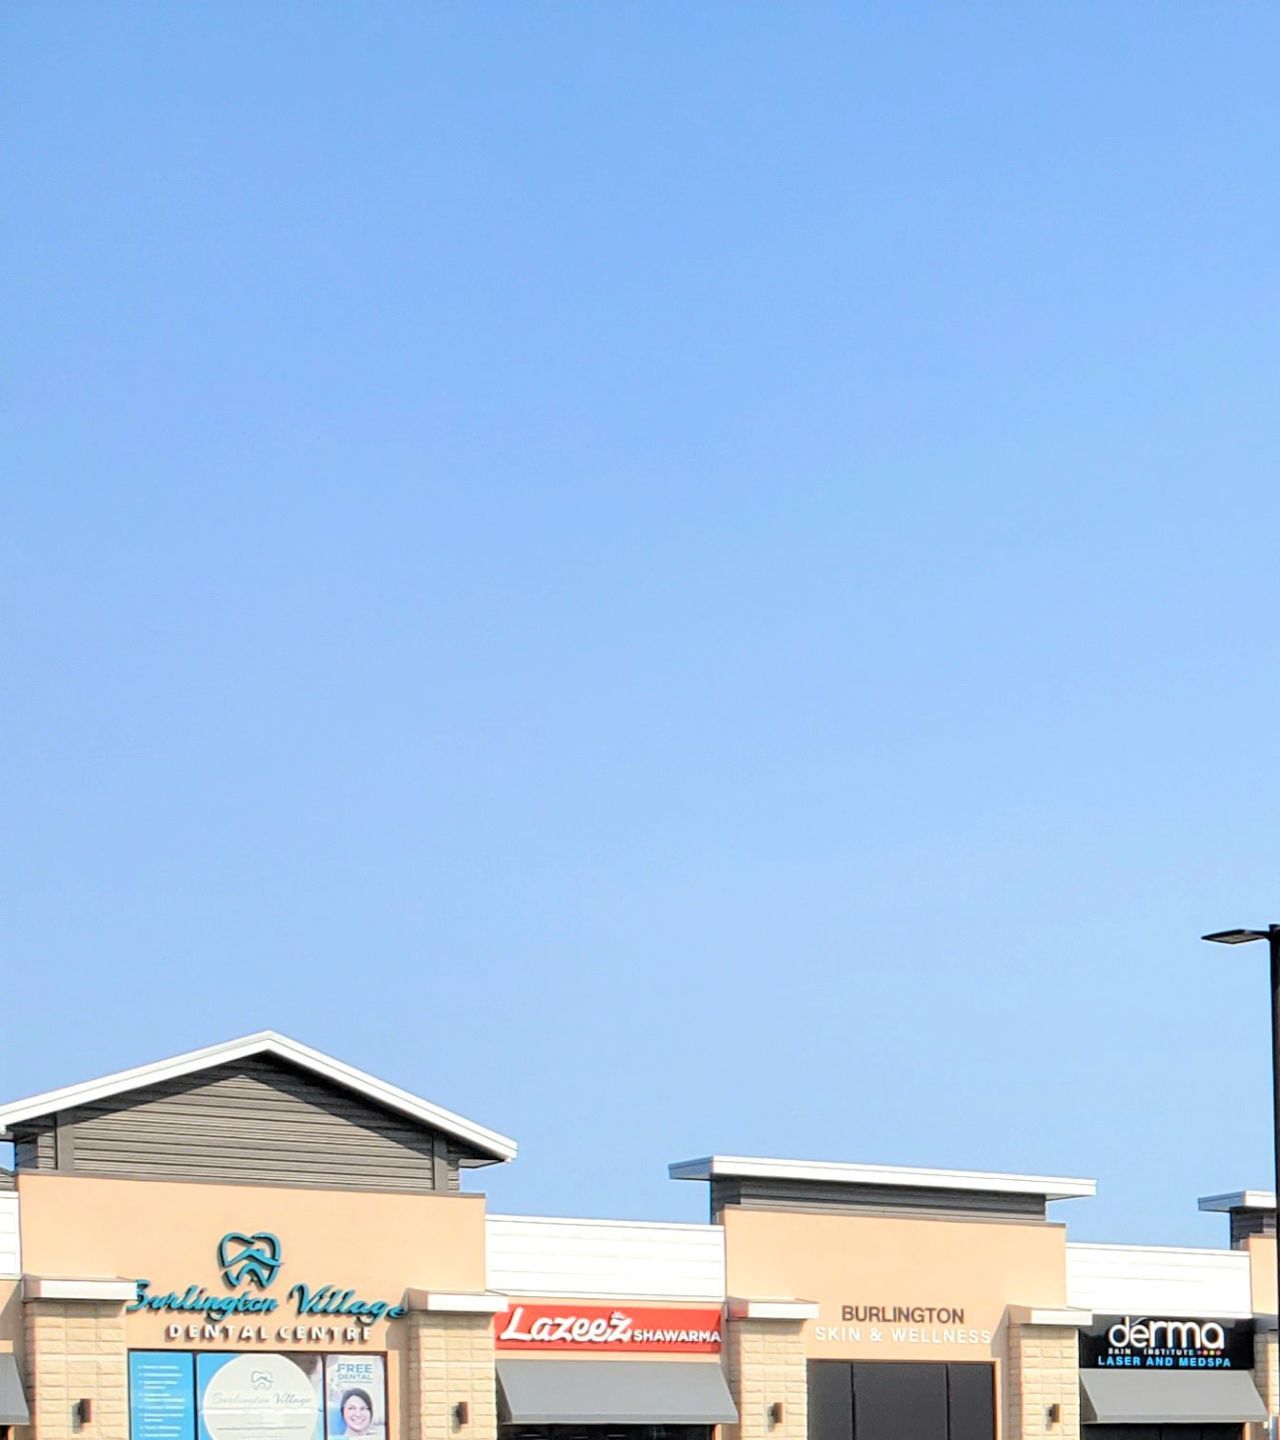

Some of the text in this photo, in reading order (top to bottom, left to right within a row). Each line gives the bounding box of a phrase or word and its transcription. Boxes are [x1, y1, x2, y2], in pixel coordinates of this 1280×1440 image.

[126, 1279, 408, 1324] Burlington Village
[841, 1305, 965, 1325] BURLINGTON
[166, 1323, 374, 1342] DENTAL CENTRE
[632, 1329, 721, 1343] SHAWARMA
[815, 1326, 992, 1344] SKIN & WELLNESS
[1143, 1348, 1195, 1356] INSTITUTE
[336, 1363, 373, 1374] FREE
[1097, 1356, 1232, 1368] LASER AND MEDSPA
[337, 1373, 373, 1381] DENTAL
